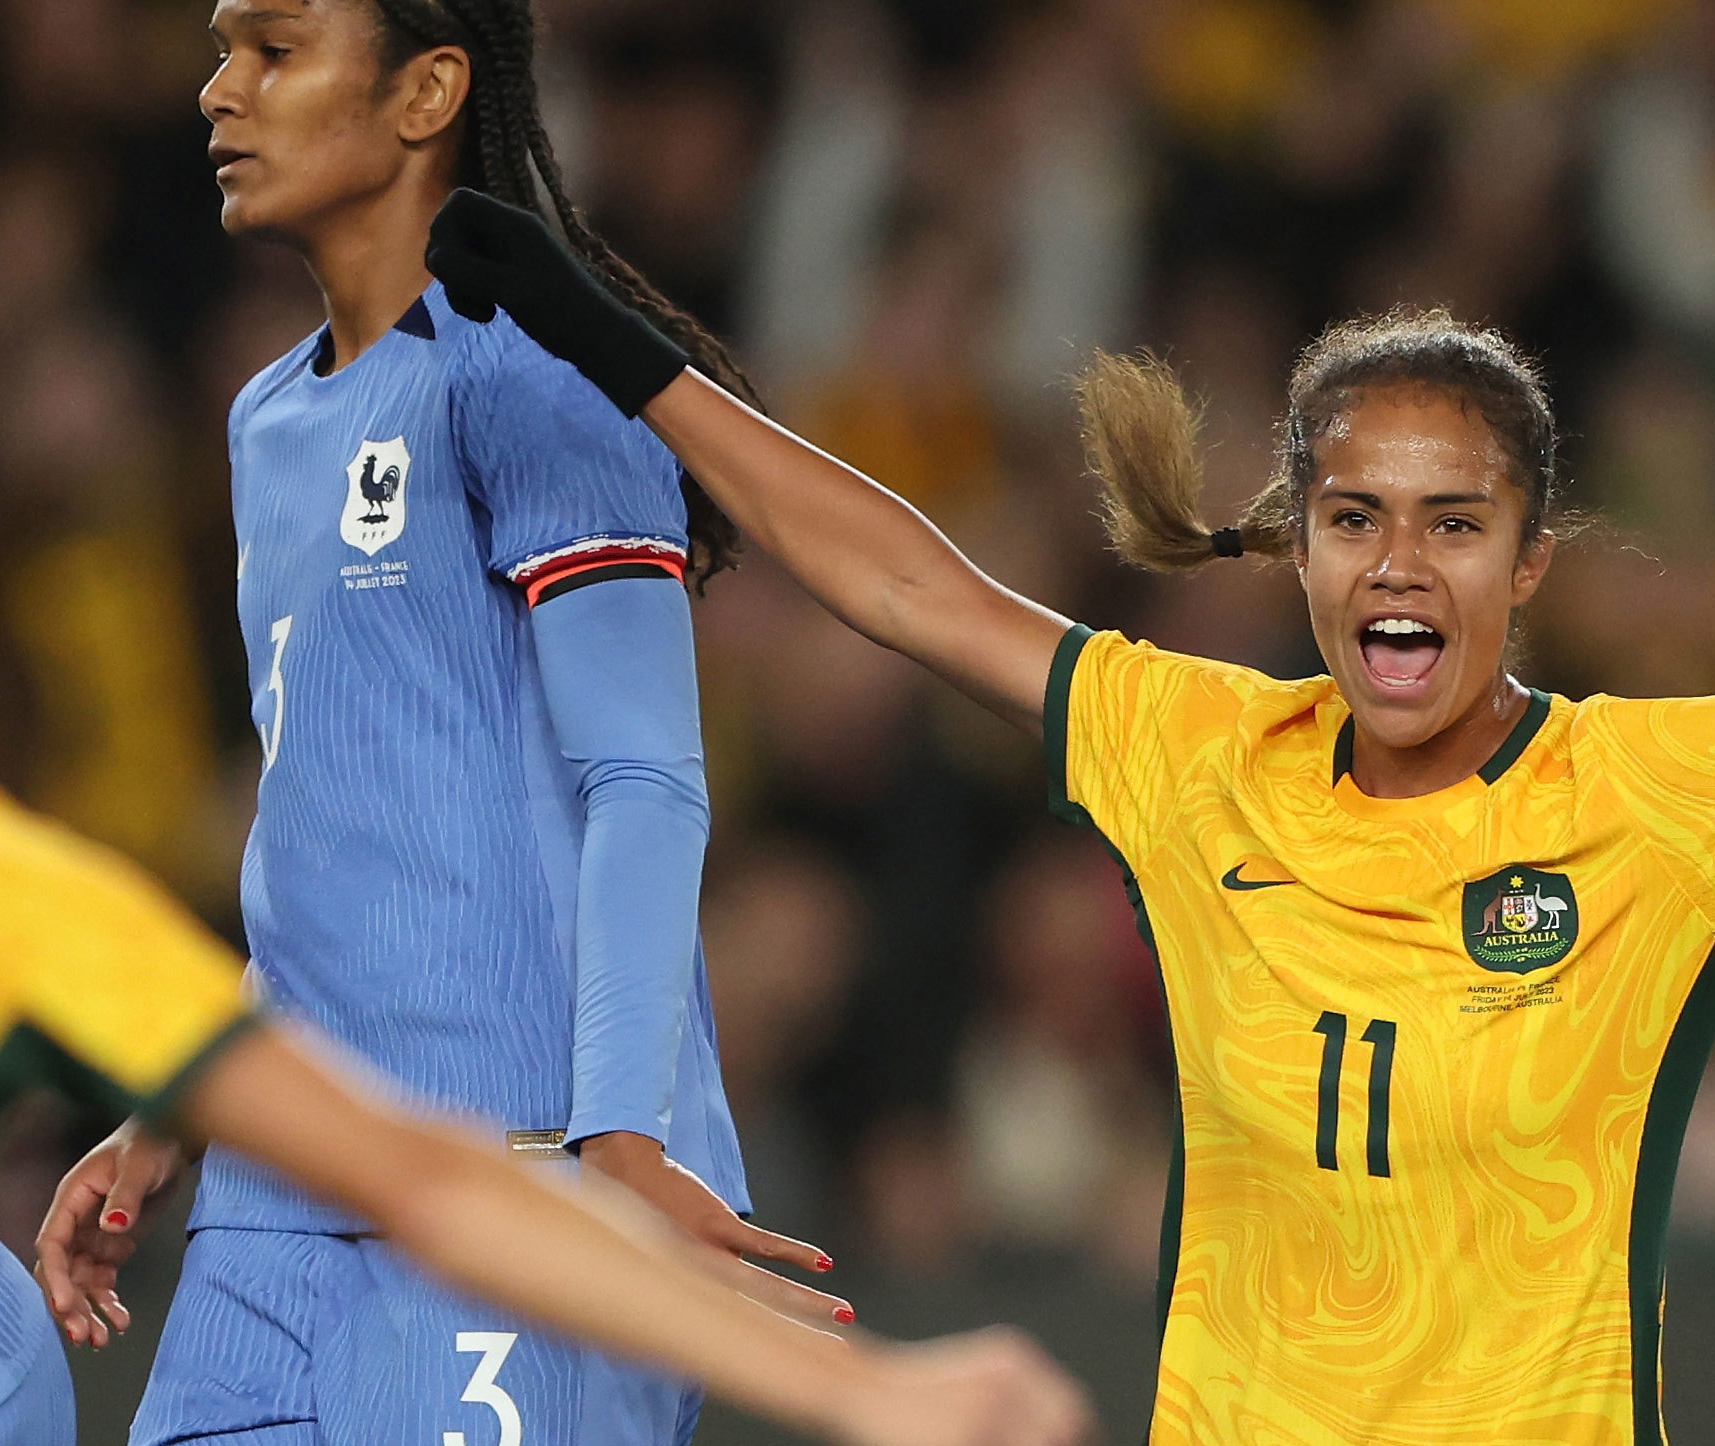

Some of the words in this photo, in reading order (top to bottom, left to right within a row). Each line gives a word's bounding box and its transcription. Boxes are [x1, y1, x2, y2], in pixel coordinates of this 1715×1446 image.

[382, 574, 406, 587] 2023
[1484, 932, 1558, 947] AUSTRALIA
[1515, 996, 1563, 1009] AUSTRALIA
[1312, 1010, 1397, 1178] 11
